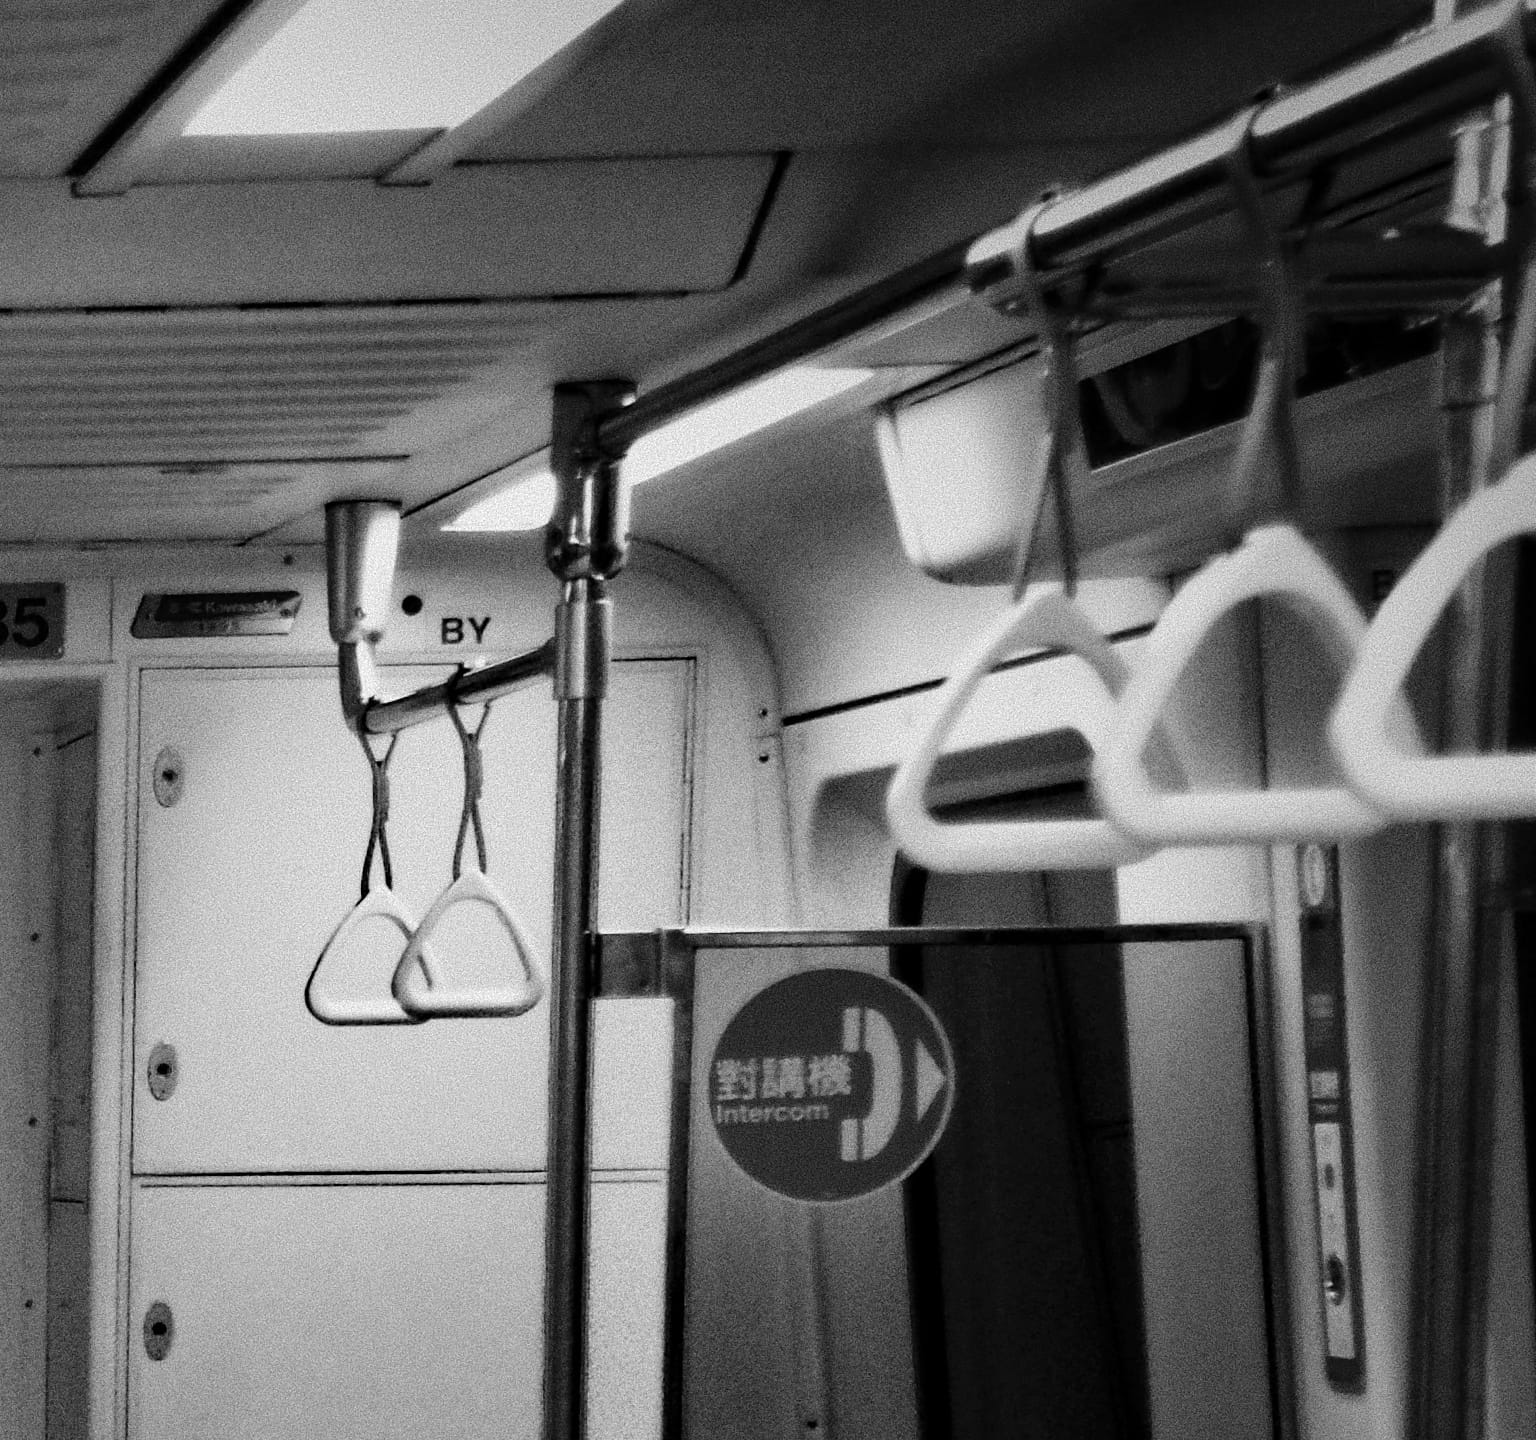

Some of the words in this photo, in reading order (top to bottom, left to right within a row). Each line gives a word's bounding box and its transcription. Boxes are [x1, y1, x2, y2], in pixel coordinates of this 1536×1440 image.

[441, 617, 491, 644] BY
[715, 1054, 853, 1100] 對講機
[715, 1104, 831, 1124] Intercom
